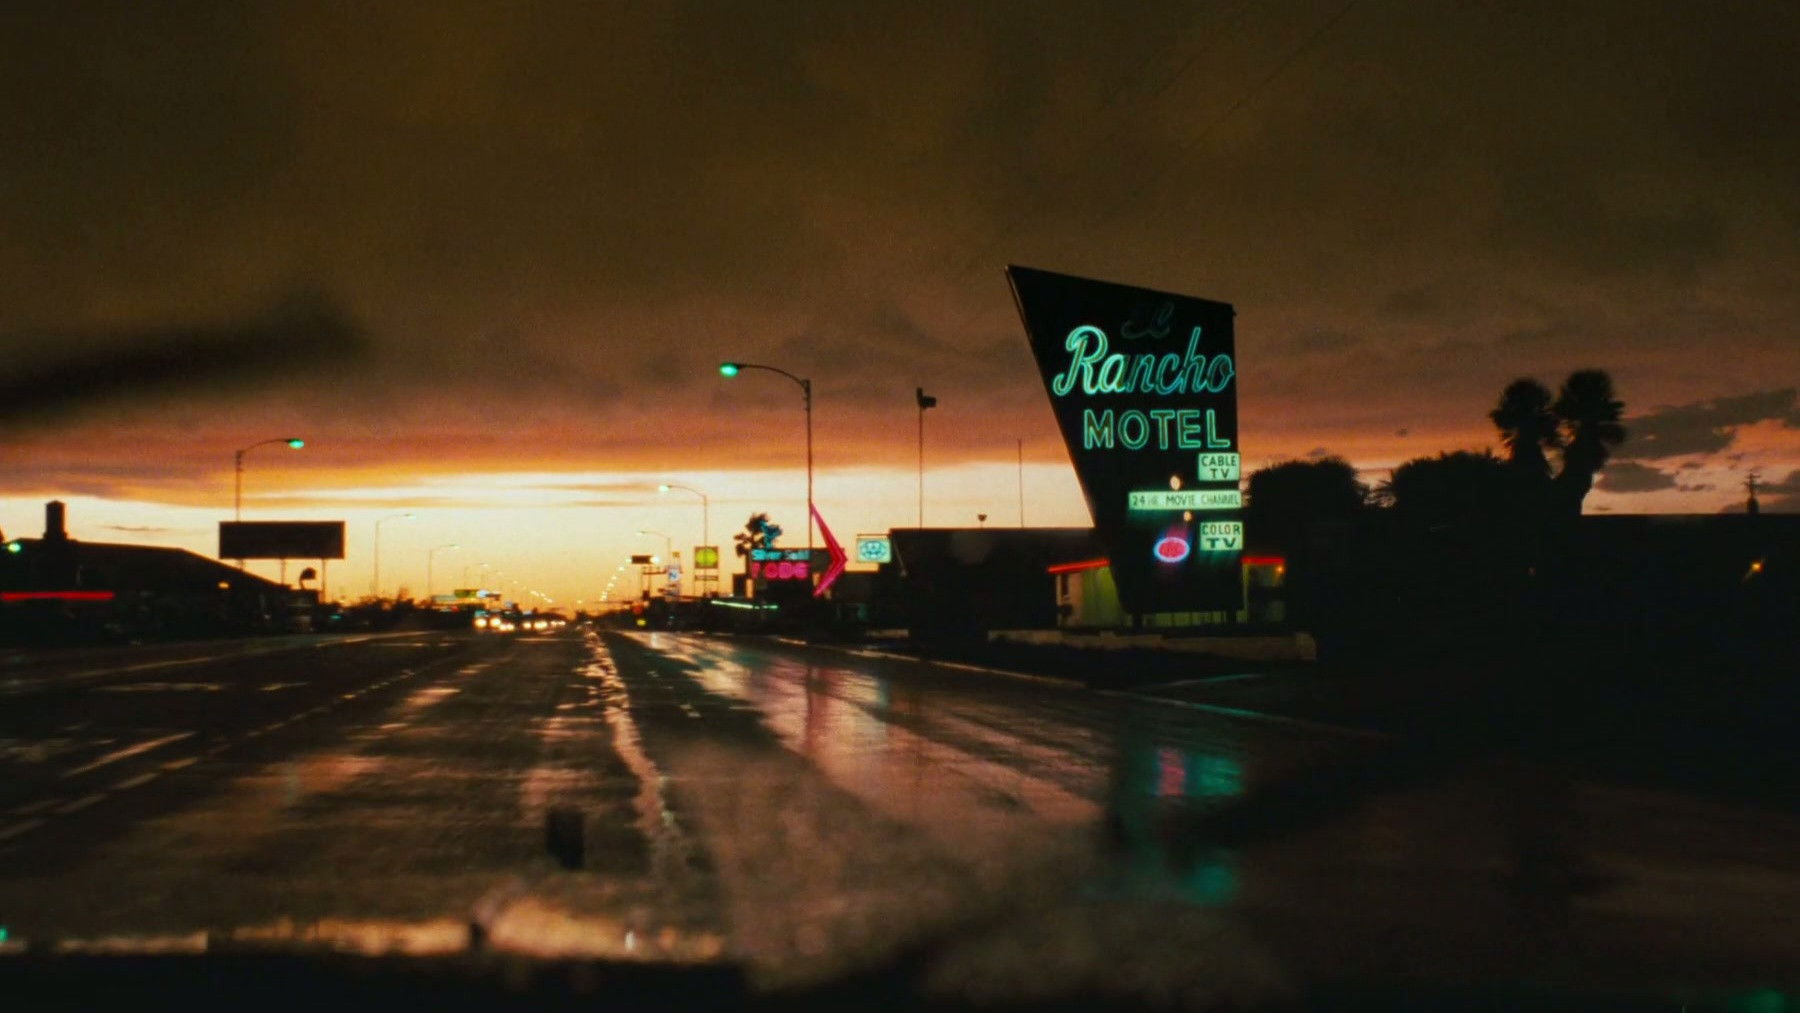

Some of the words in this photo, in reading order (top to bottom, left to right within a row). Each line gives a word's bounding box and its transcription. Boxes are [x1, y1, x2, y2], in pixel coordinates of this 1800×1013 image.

[1053, 325, 1236, 396] Rancho
[1084, 409, 1231, 450] MOTEL
[1201, 455, 1237, 467] CABLE
[1210, 468, 1230, 479] TV
[1166, 495, 1195, 506] MOVIE
[1201, 493, 1239, 505] CHANNEL
[1201, 524, 1241, 535] COLOR
[1206, 538, 1236, 548] TV
